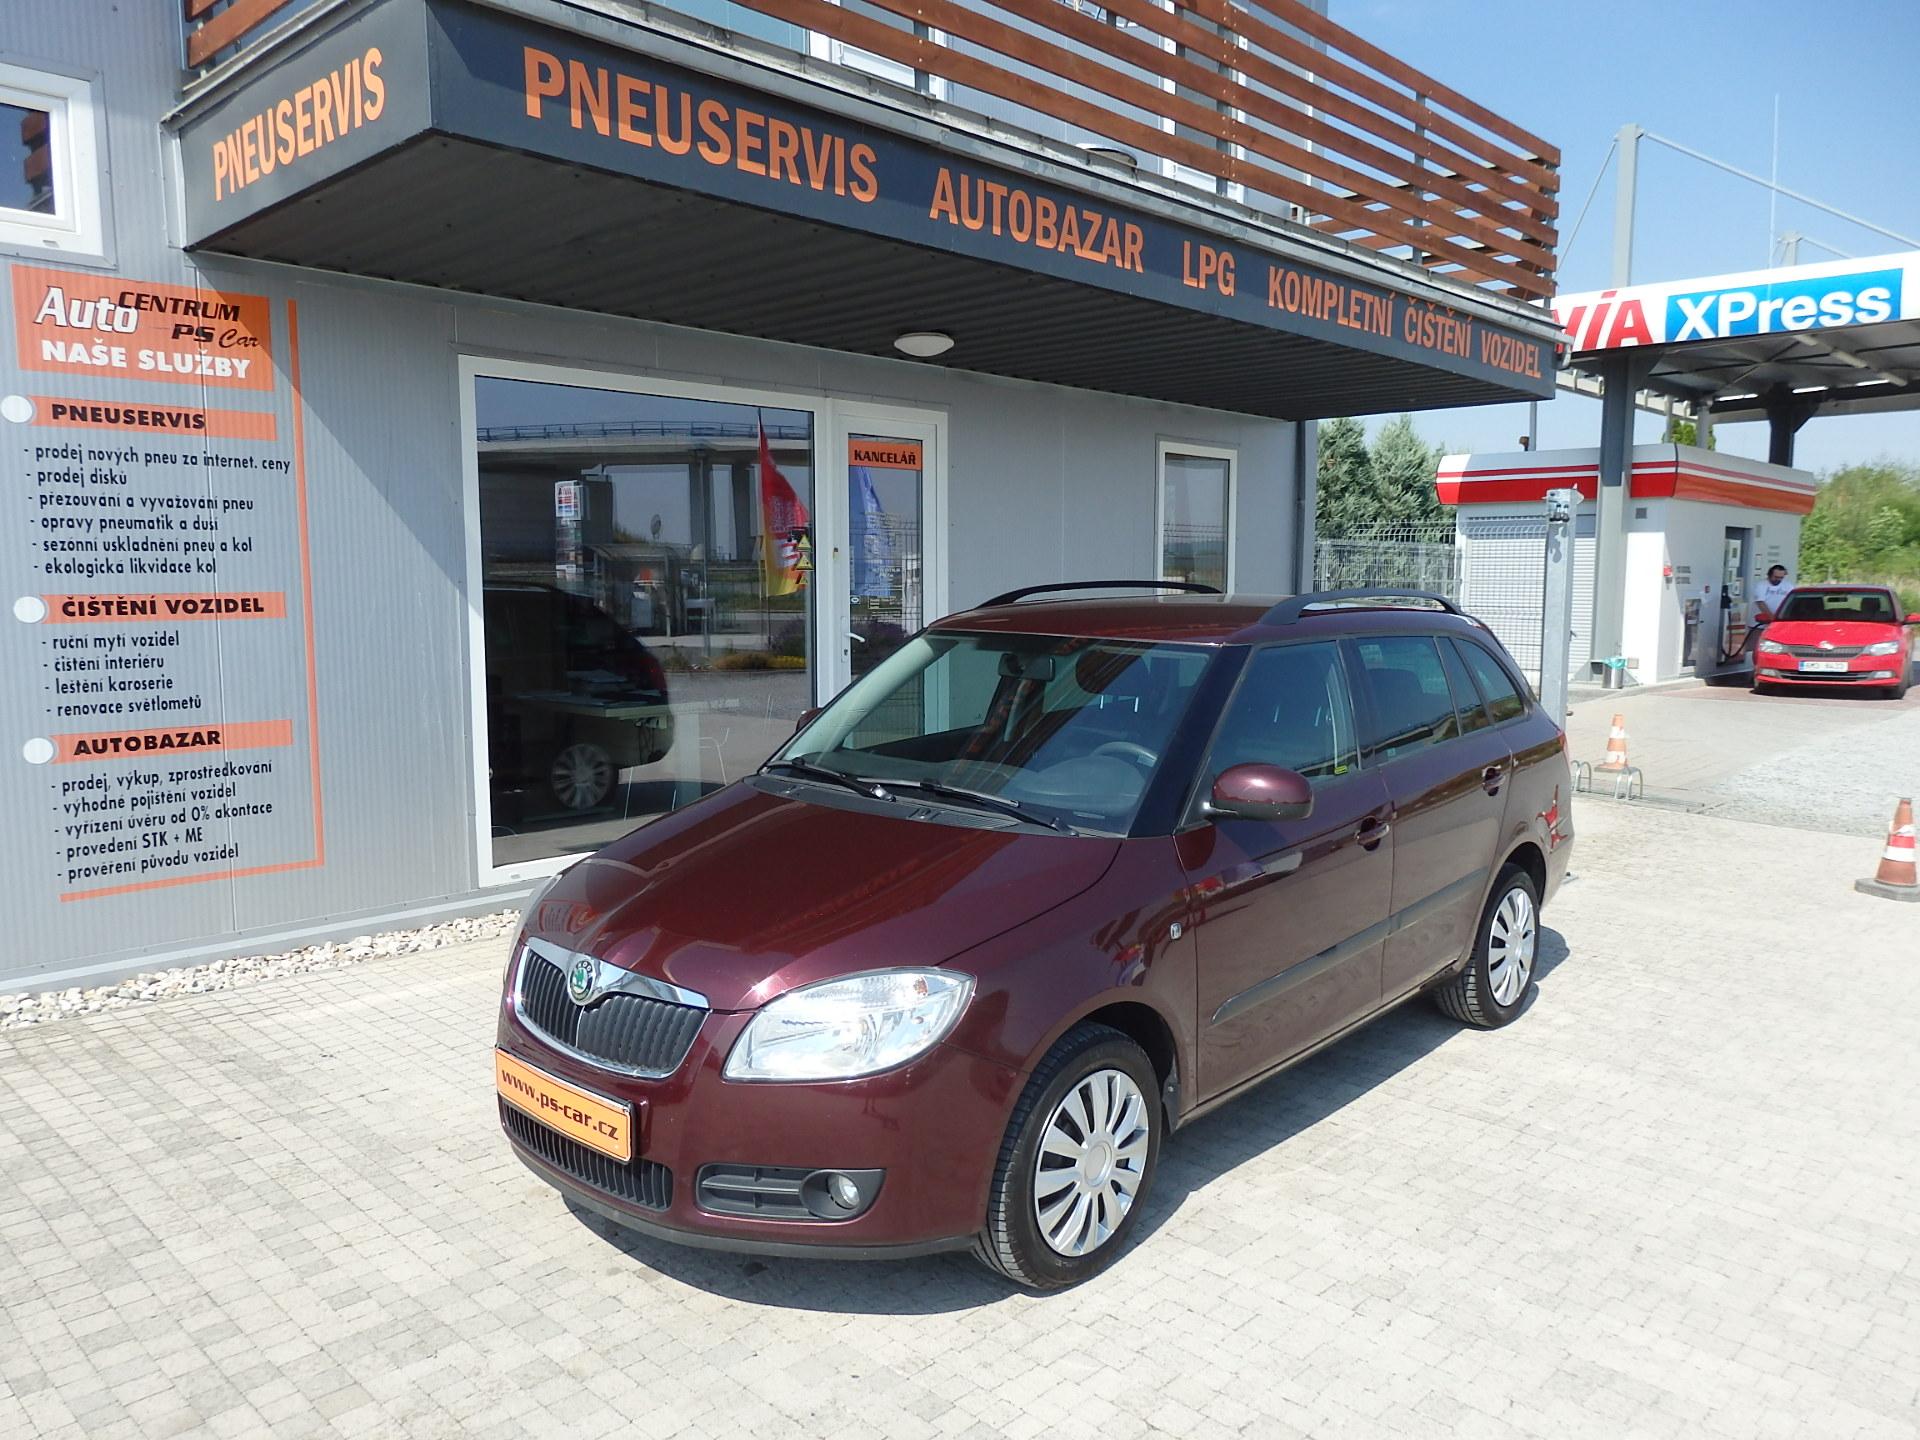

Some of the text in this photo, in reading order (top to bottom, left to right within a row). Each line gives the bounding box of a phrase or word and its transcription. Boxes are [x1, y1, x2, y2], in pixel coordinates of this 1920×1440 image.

[213, 46, 385, 202] PNEUSERVIS
[523, 46, 1542, 379] PNEUSERVIS AUTOBAZAR LPG KOMPLETNÍ ČIŠTĚNÍ VOZIDEL
[34, 285, 241, 334] Auto CENTRUM
[1674, 286, 1892, 342] XPress
[171, 323, 260, 348] PS Car
[41, 338, 251, 379] NAŠE SLUŽBY
[51, 403, 206, 430] PNEUSERVIS
[36, 443, 290, 474] prodej nových pneu za internet. ceny
[854, 449, 916, 465] KANCELÁŘ
[37, 466, 84, 488] prodej
[126, 497, 134, 507] a
[223, 499, 254, 513] pneu
[41, 517, 93, 533] opravy
[99, 514, 174, 533] pneumatik
[180, 520, 187, 530] a
[184, 541, 215, 555] pneu
[220, 541, 227, 551] a
[232, 536, 252, 552] kol
[130, 557, 191, 574] likvidace
[197, 557, 216, 574] kol
[62, 595, 265, 617] ČIŠTĚNÍ VOZIDEL
[131, 630, 180, 647] vozidel
[108, 674, 173, 691] karoserie
[57, 699, 123, 717] renovace
[73, 730, 222, 756] AUTOBAZAR
[62, 773, 111, 796] prodej,
[117, 769, 163, 791] výkup,
[191, 781, 236, 800] vozidel
[171, 807, 186, 824] od
[191, 805, 210, 822] 0%
[215, 803, 273, 819] akontace
[67, 836, 138, 862] provedení
[142, 831, 168, 849] STK
[185, 827, 204, 843] ME
[194, 842, 239, 863] vozidel
[502, 1069, 619, 1140] www.ps-car.cz
